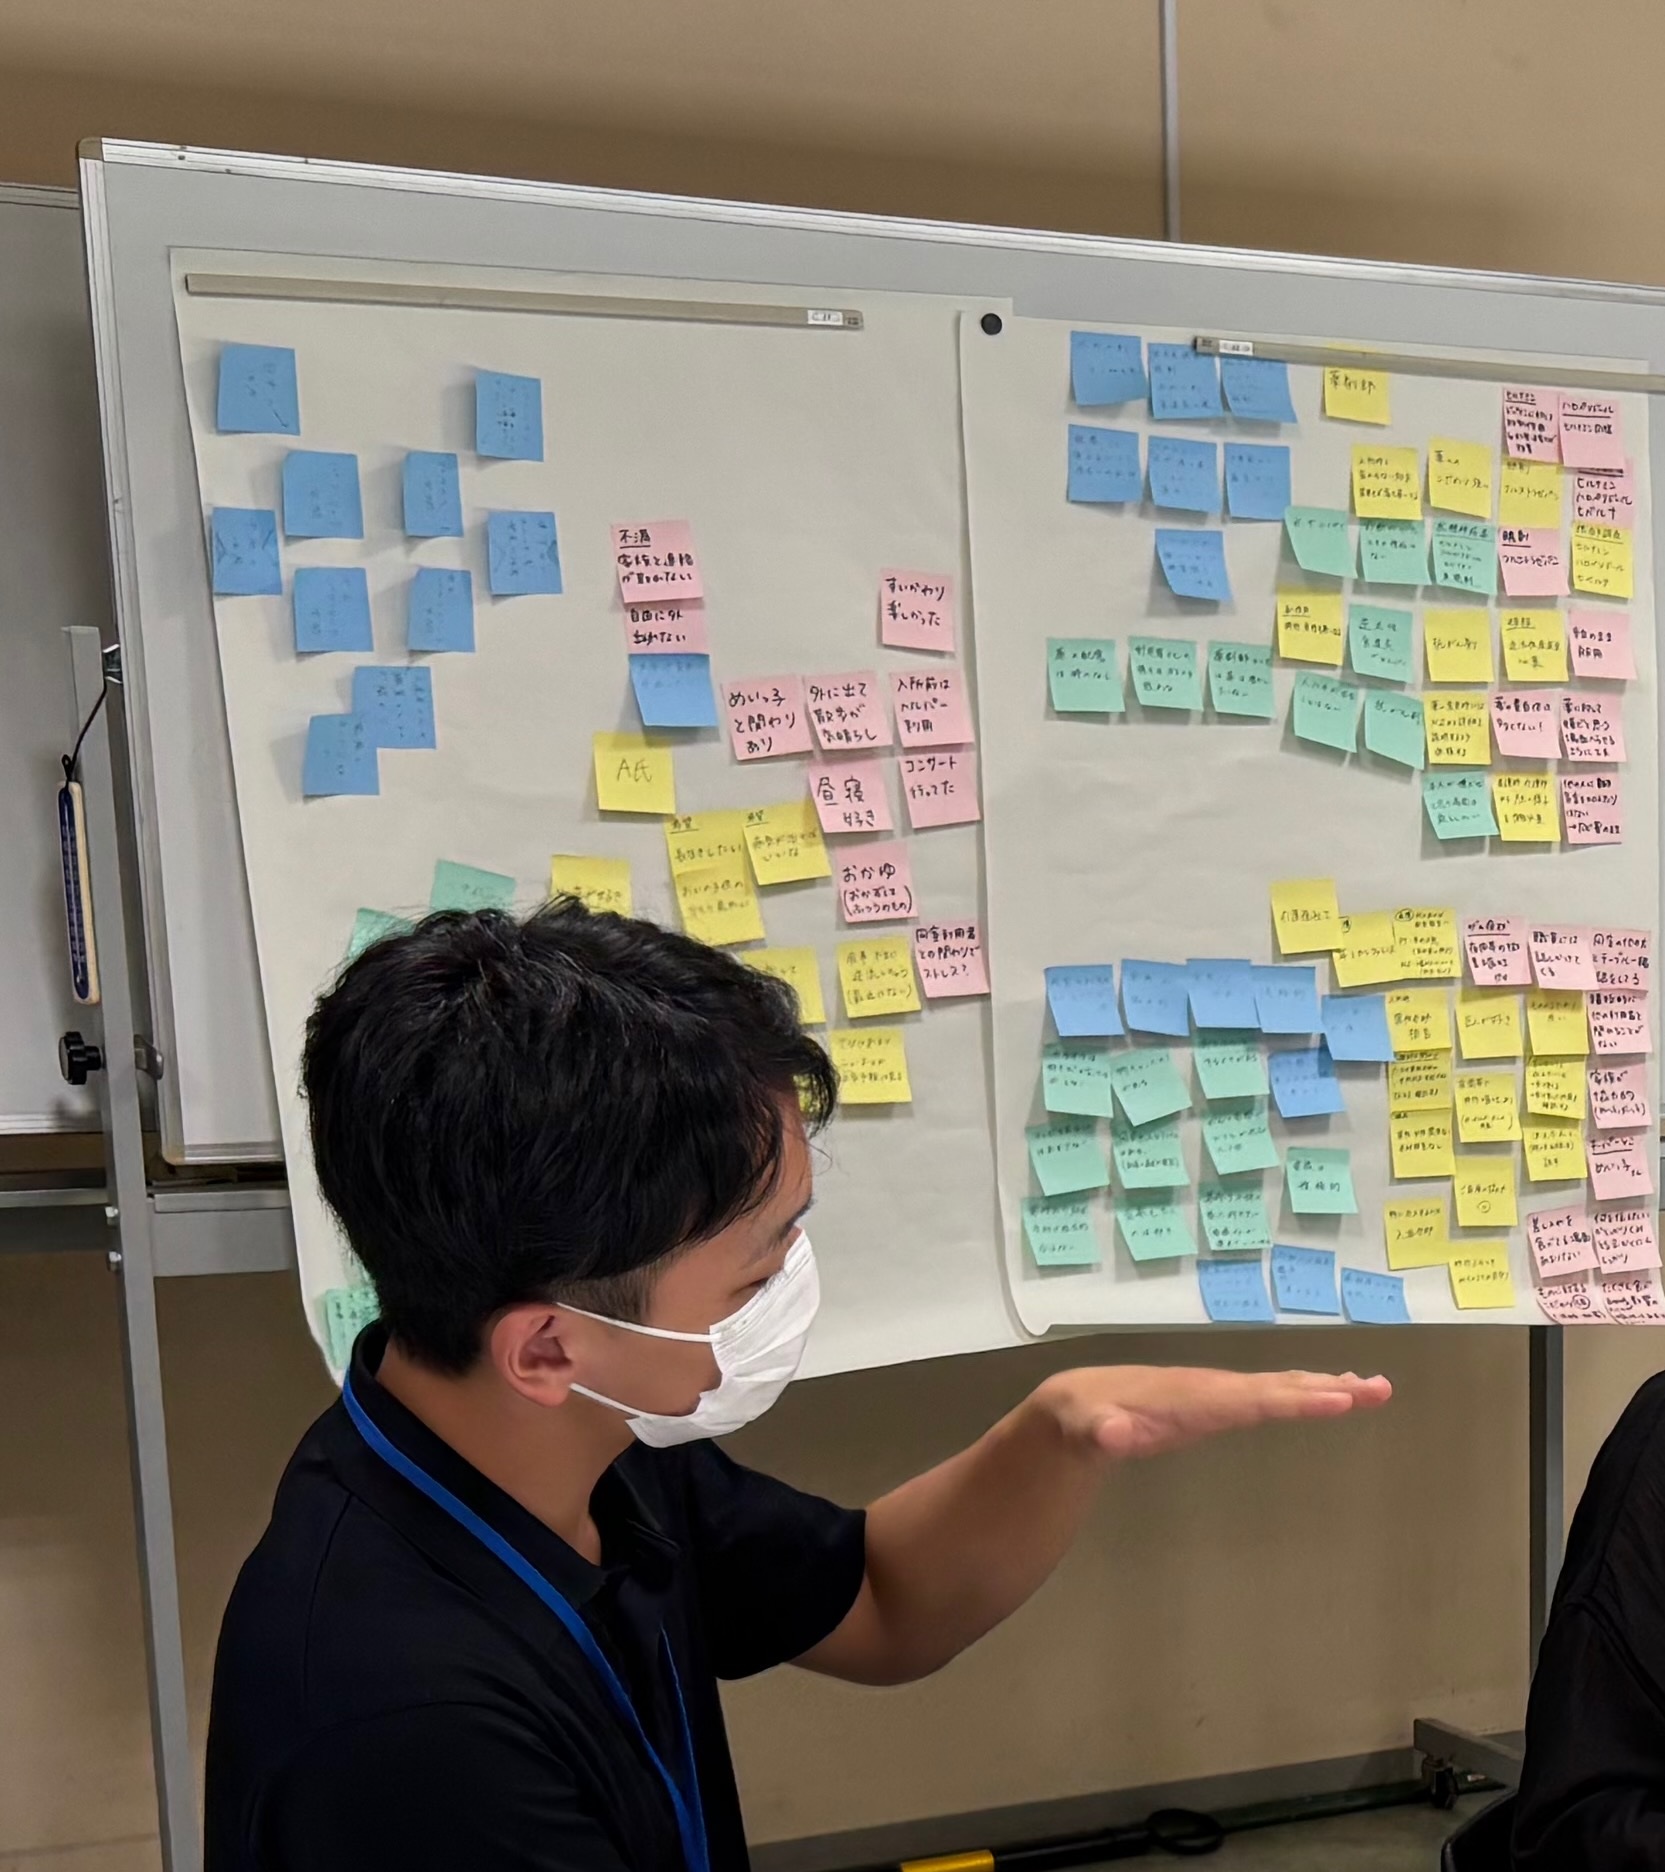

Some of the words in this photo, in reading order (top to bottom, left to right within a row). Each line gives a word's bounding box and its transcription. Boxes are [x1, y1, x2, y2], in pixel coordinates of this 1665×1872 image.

[809, 683, 867, 701] 外に出て
[905, 755, 957, 773] コンサート
[842, 863, 896, 883] おかゆ
